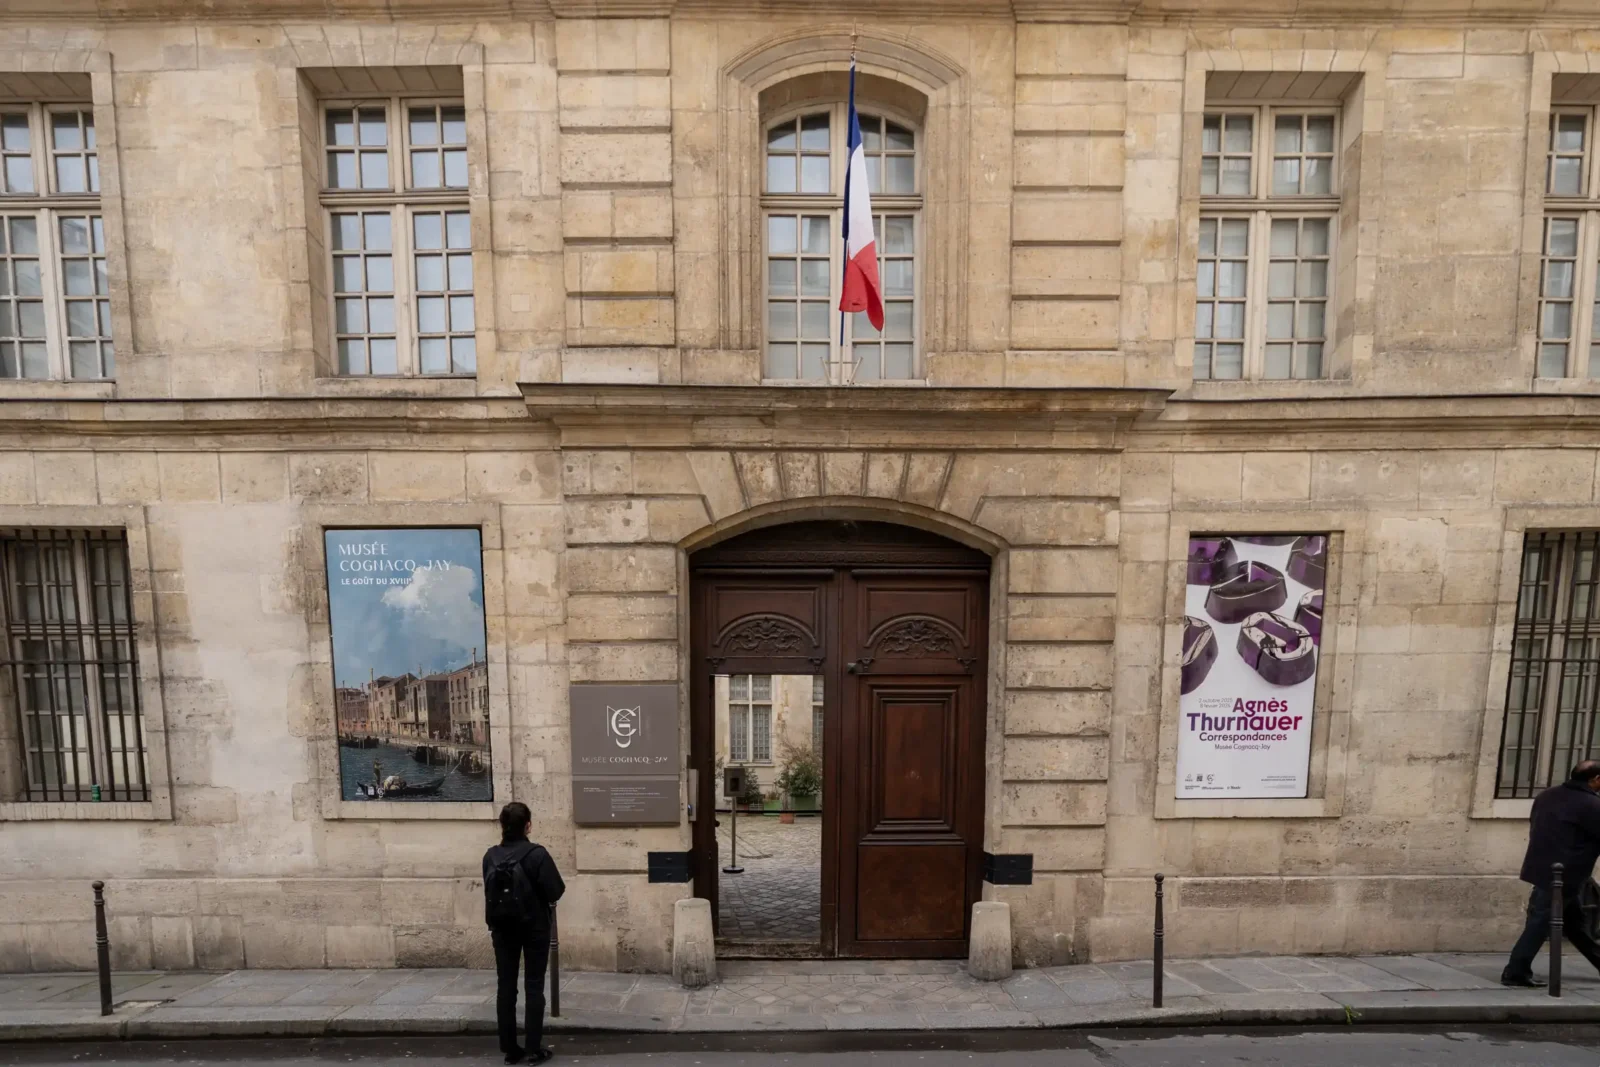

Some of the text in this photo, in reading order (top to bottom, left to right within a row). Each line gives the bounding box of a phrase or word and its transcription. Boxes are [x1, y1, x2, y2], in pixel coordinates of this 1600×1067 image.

[338, 541, 388, 556] MUSÉE
[352, 576, 374, 585] GOÛT
[376, 577, 387, 585] DU
[1232, 697, 1288, 717] Agnès
[1186, 712, 1303, 731] Thurnauer
[1199, 732, 1287, 743] Correspondances
